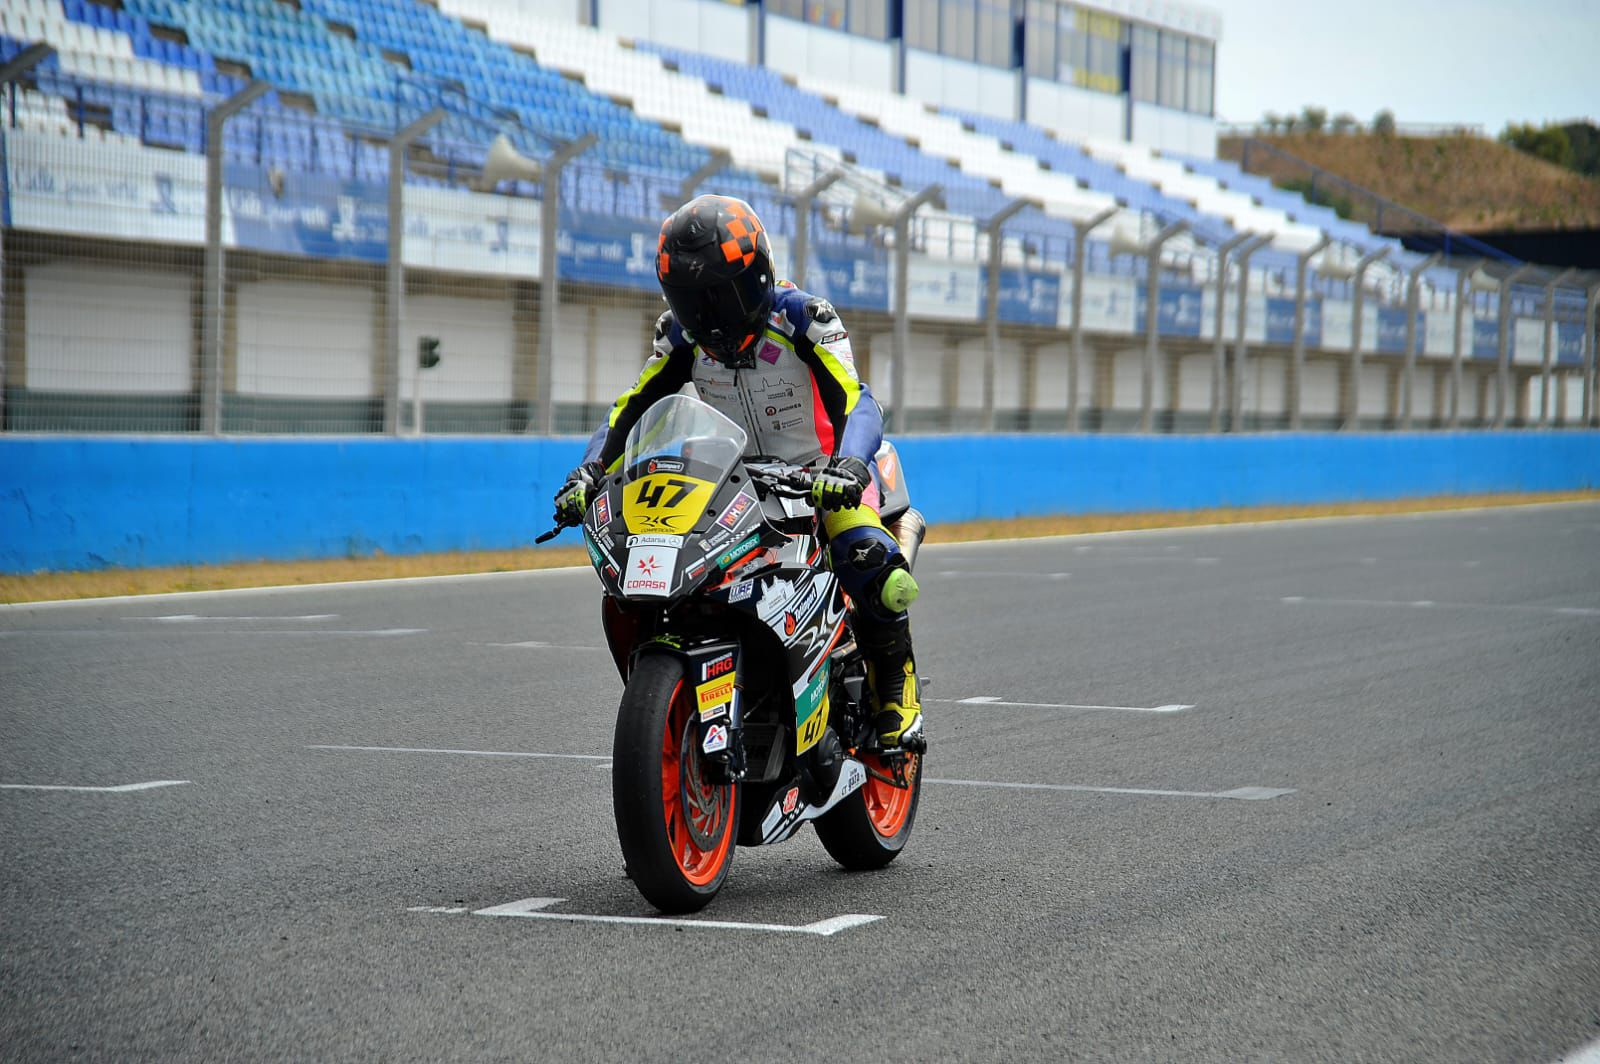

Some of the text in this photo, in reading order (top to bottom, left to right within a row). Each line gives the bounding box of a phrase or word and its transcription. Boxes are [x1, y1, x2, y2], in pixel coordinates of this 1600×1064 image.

[635, 479, 698, 508] 47
[729, 537, 759, 559] MOTOREX
[627, 580, 666, 590] COPASA
[707, 657, 733, 679] HRG
[700, 682, 732, 703] PIRELLI
[803, 705, 823, 743] 47
